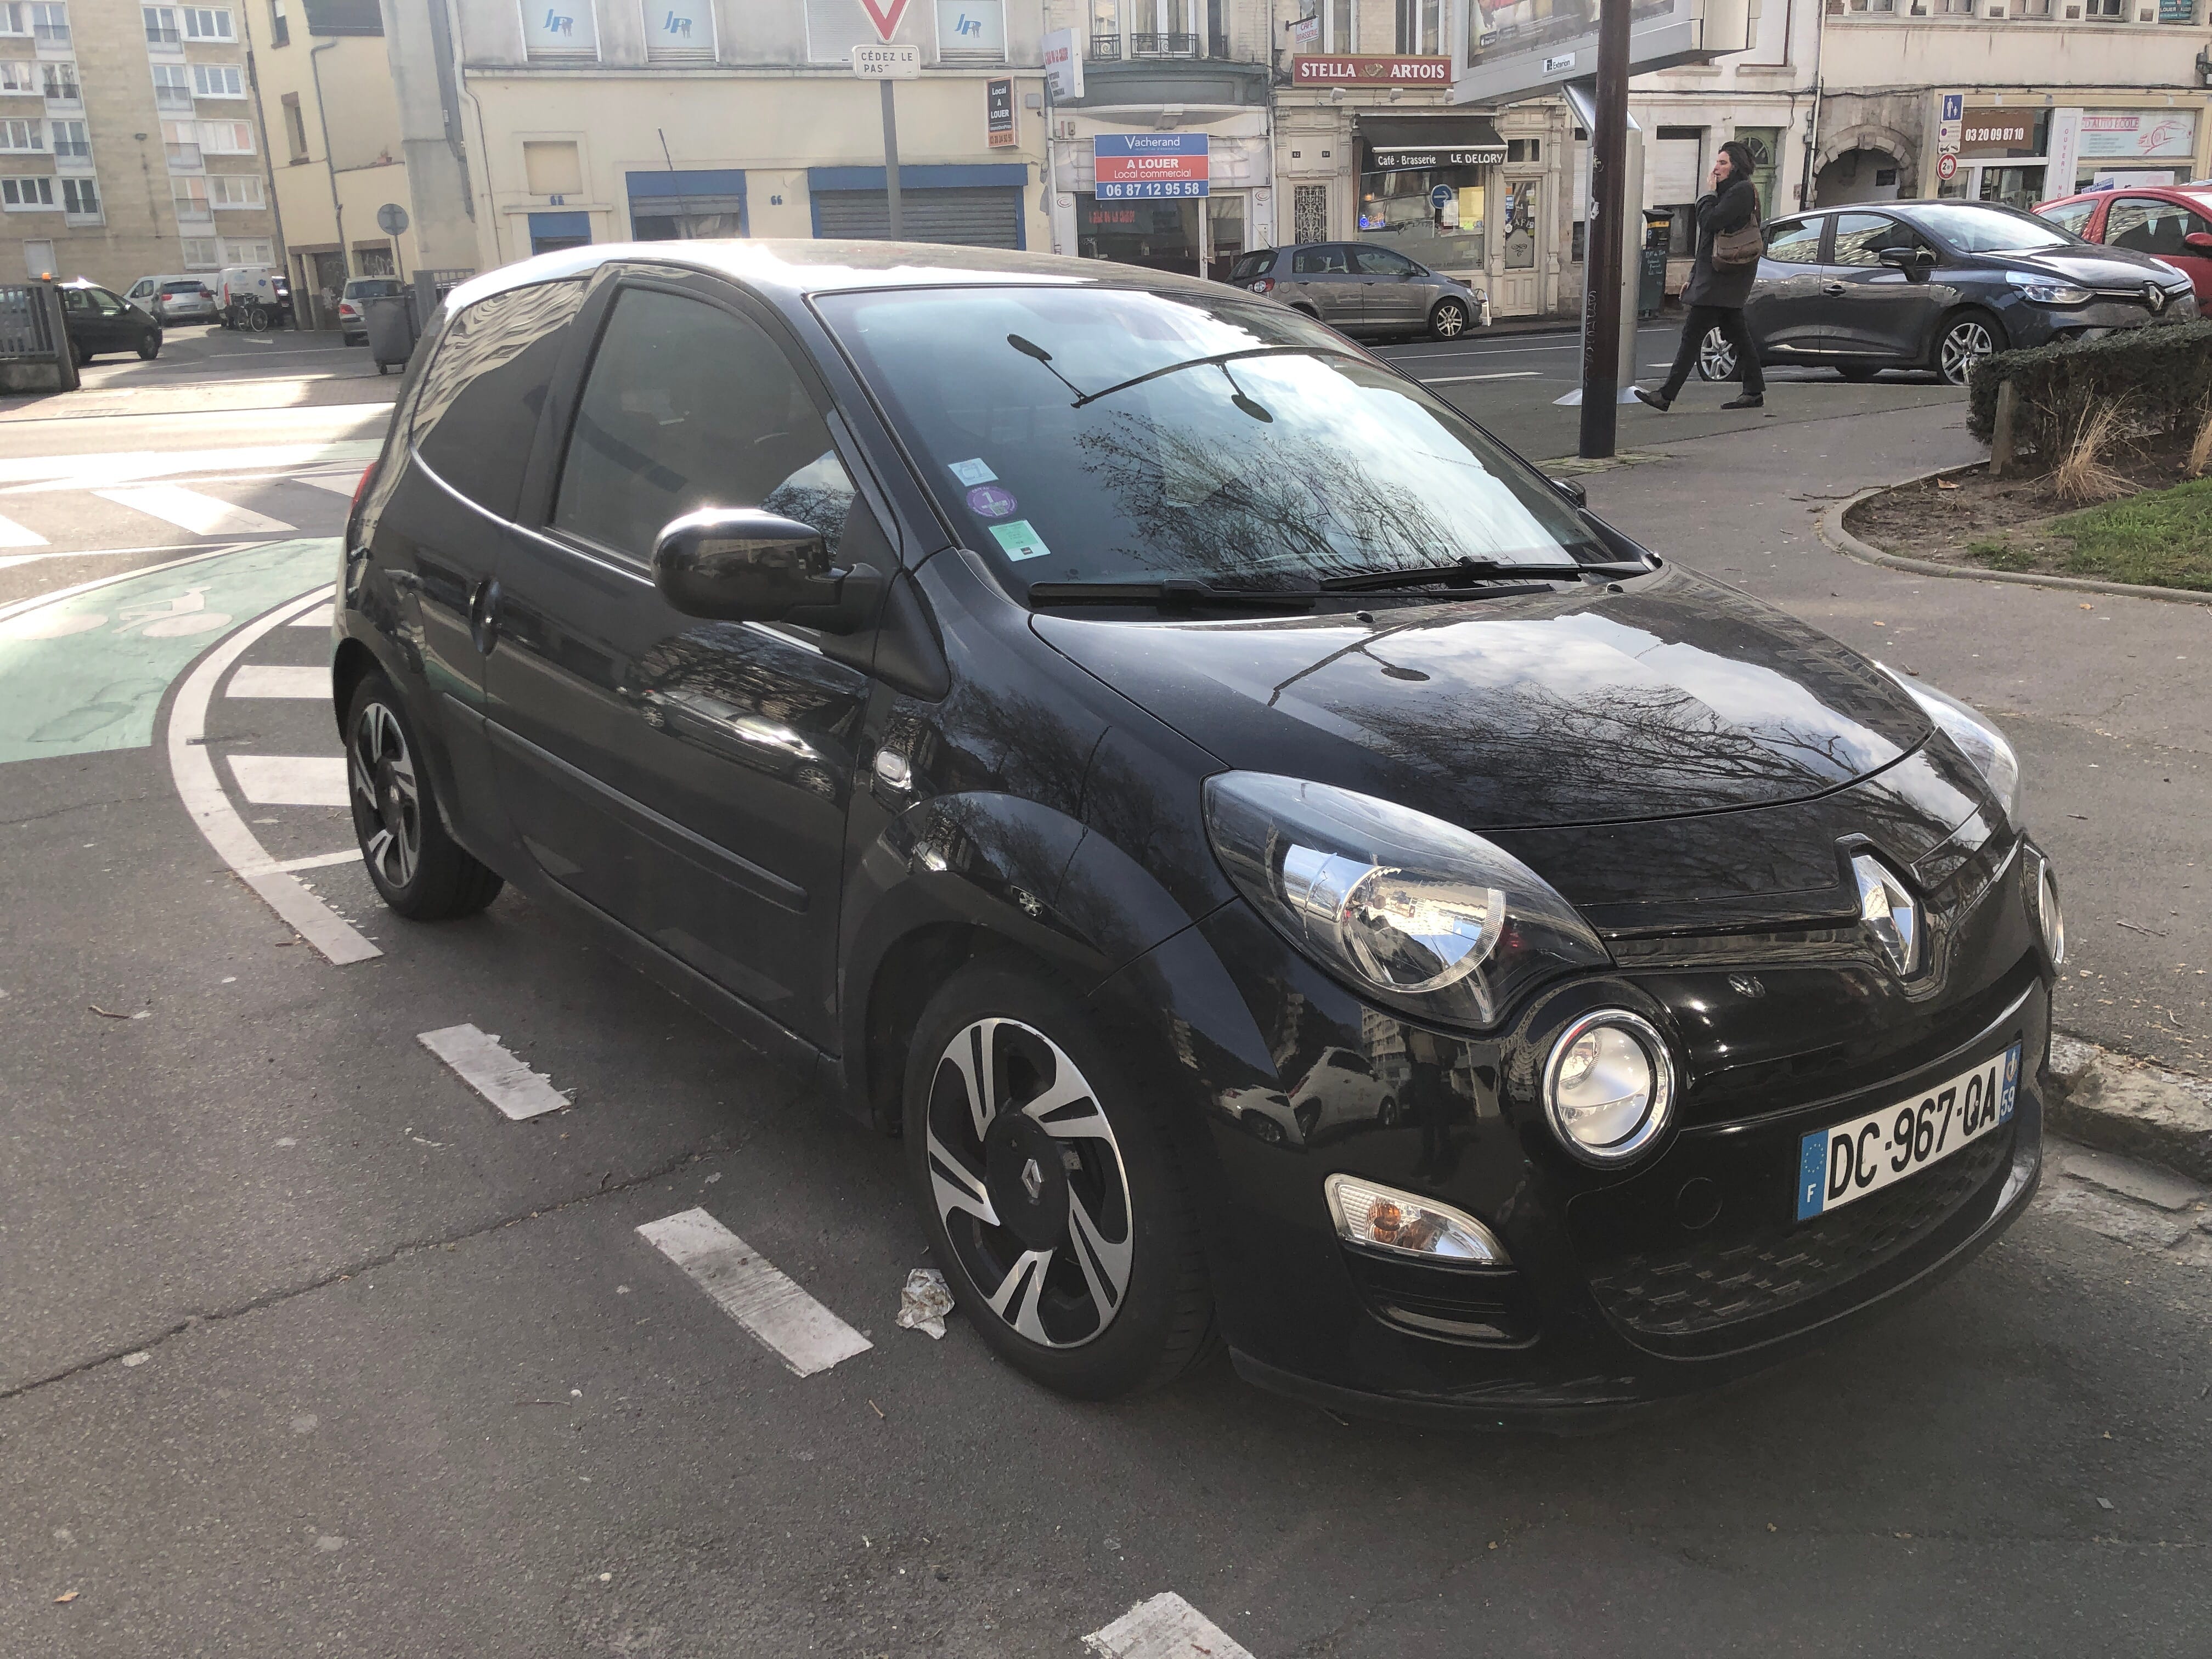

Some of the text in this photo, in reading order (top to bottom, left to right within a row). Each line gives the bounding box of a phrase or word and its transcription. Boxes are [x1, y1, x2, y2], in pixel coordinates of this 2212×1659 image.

[861, 50, 913, 61] CÉDEZ LE
[1301, 63, 1444, 78] STELLA ARTOIS
[992, 86, 1006, 95] Local
[991, 109, 1009, 119] LOUER
[2092, 119, 2113, 128] AUTO
[1965, 128, 1977, 141] 03
[1978, 128, 1989, 141] 20
[1990, 128, 2002, 140] 09
[2003, 128, 2013, 140] 87
[2015, 127, 2024, 140] 10
[1125, 136, 1180, 149] Vacherand
[2060, 128, 2069, 174] OUVERT
[1127, 159, 1179, 169] A LOUER
[1378, 155, 1395, 165] Café
[1401, 155, 1436, 165] Brasserie
[1451, 153, 1462, 163] LE
[1465, 153, 1503, 163] DELORY
[1114, 169, 1191, 179] Local commercial
[1106, 182, 1199, 196] 06 87 12 95 58
[771, 195, 782, 206] 66
[2001, 1086, 2016, 1117] 59
[1827, 1066, 1996, 1201] DC-967-QA
[1807, 1183, 1816, 1203] F
